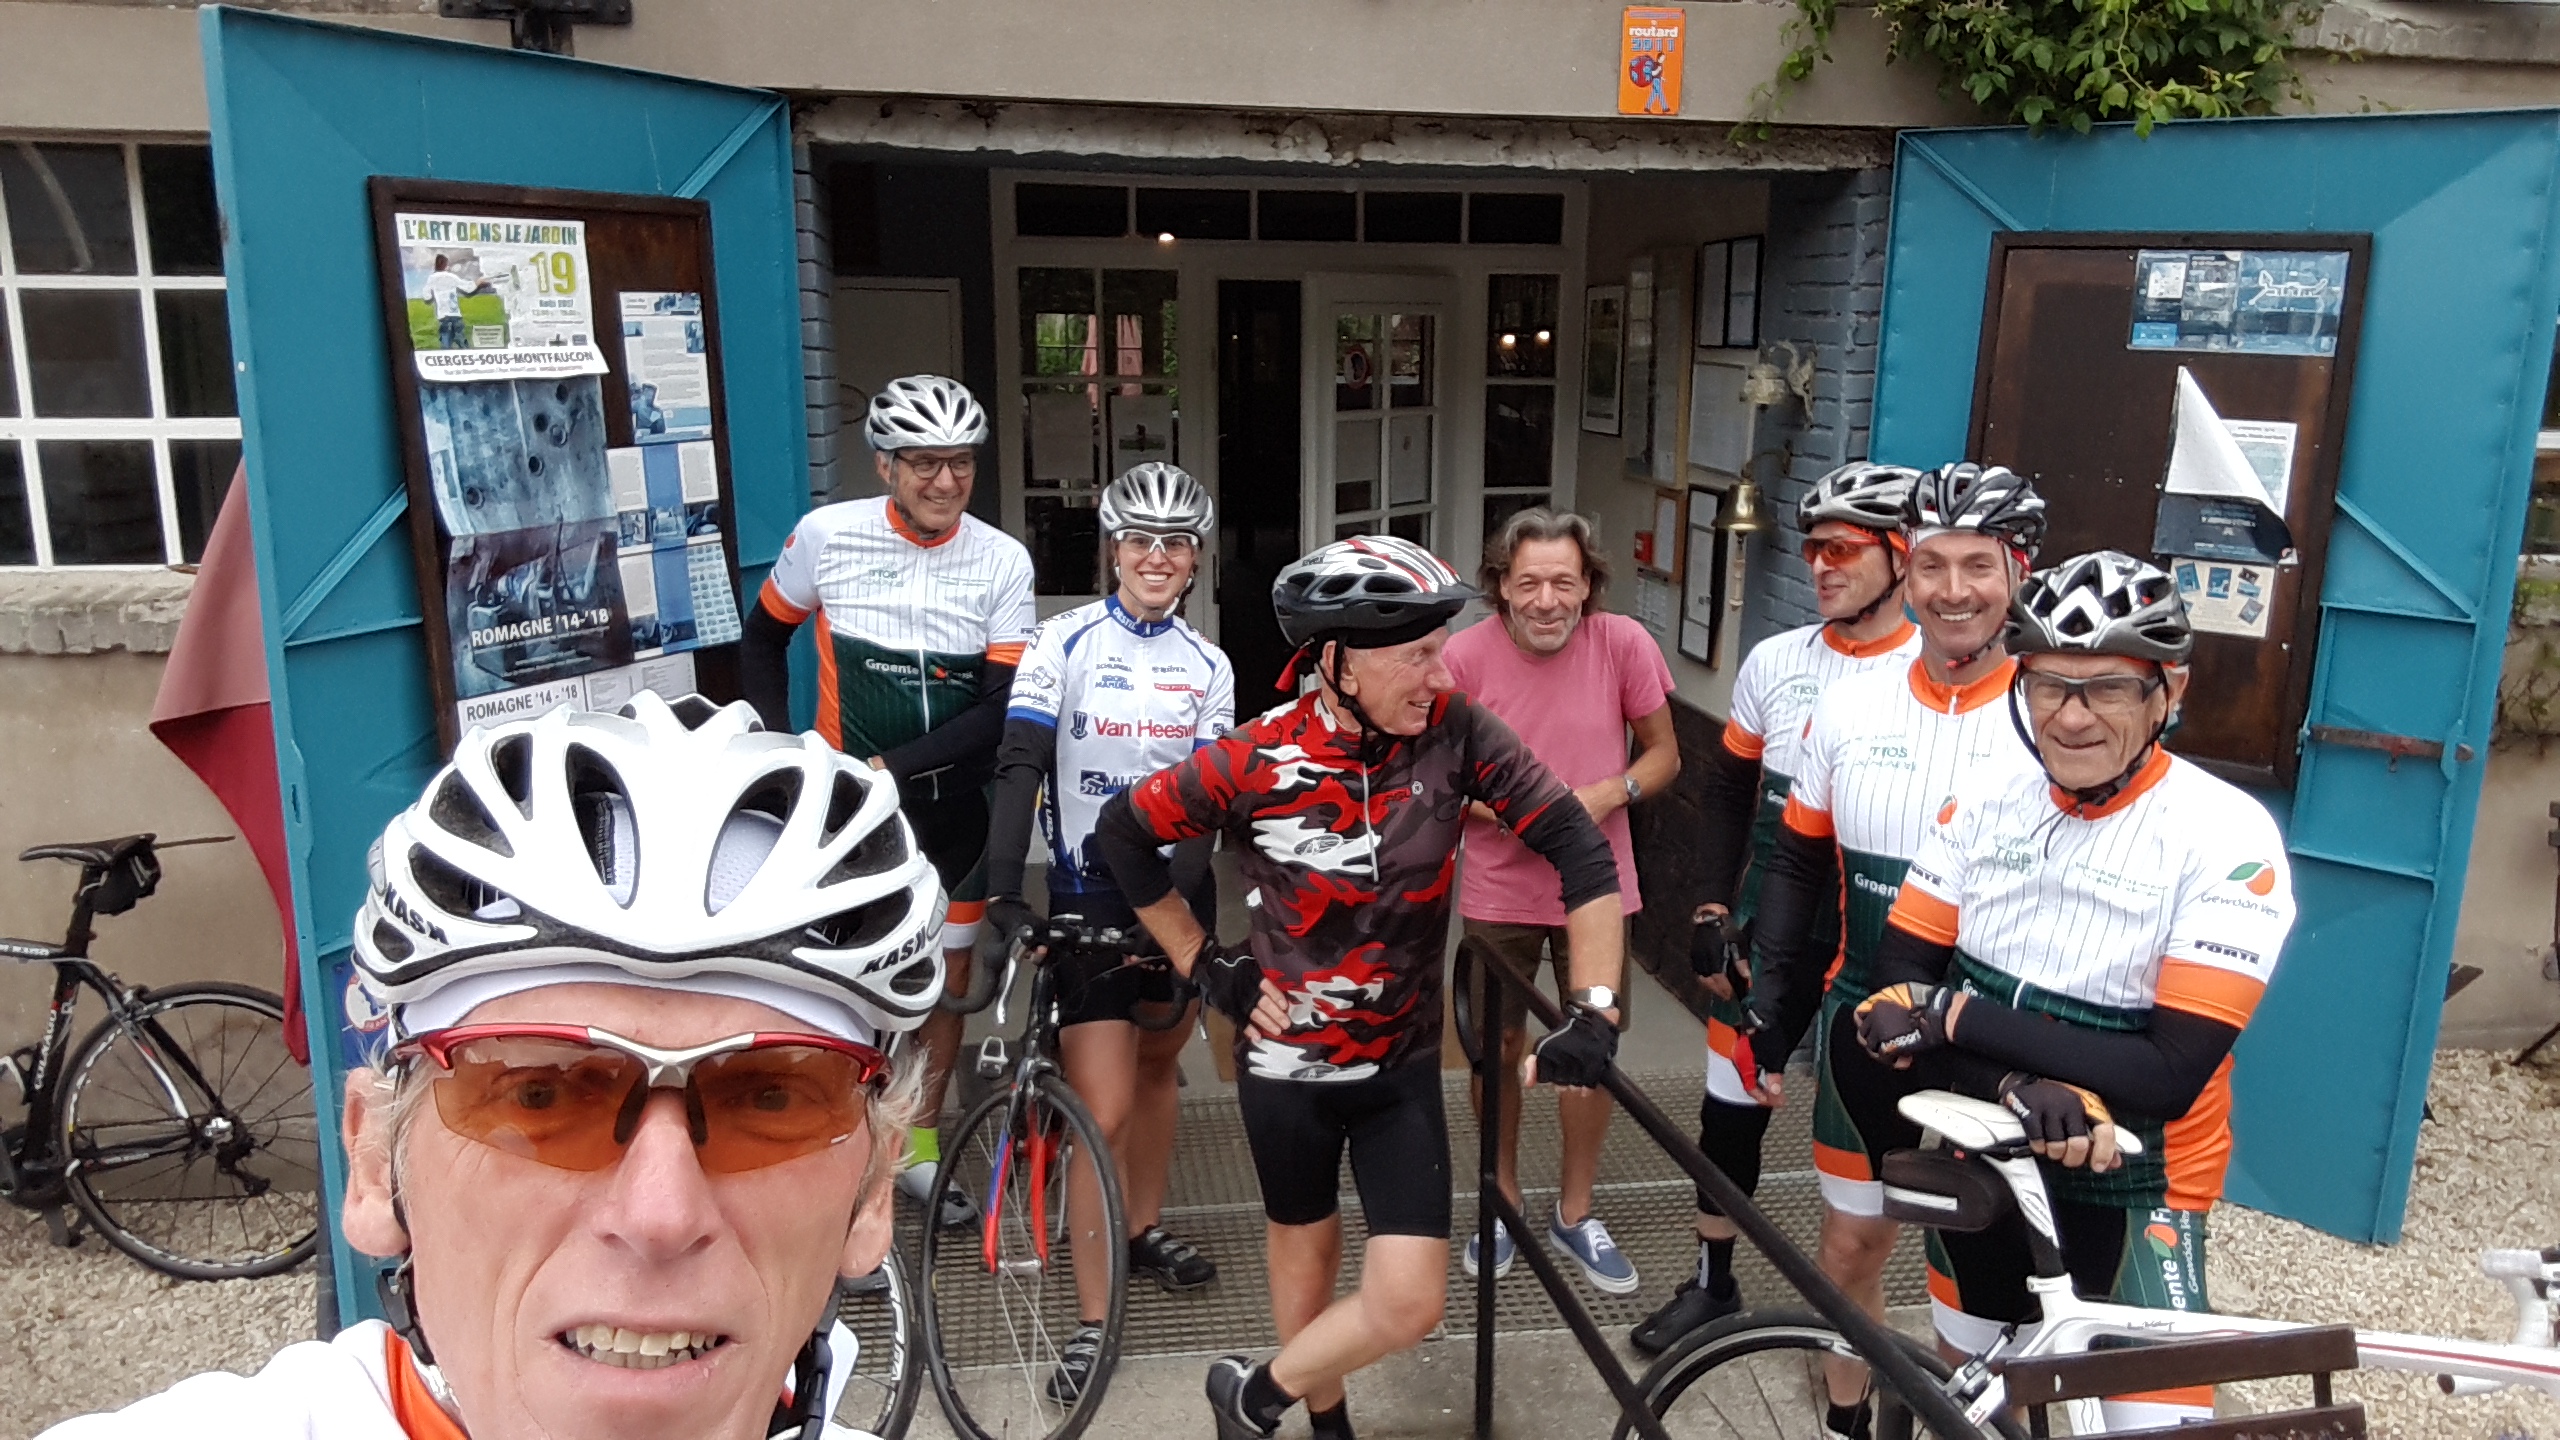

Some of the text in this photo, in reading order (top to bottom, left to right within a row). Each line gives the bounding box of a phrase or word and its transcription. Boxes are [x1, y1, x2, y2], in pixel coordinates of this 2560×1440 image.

[1629, 26, 1679, 38] routard
[403, 219, 578, 246] L'ART DANS LE JARDIN
[529, 251, 577, 295] 19
[424, 351, 595, 367] CIERGES-SOUS-MONTFAUCON
[471, 618, 553, 648] ROMAGNE
[466, 693, 533, 722] ROMAGNE
[1094, 716, 1132, 737] Van
[1854, 873, 1900, 899] Groen
[856, 925, 926, 979] KASK
